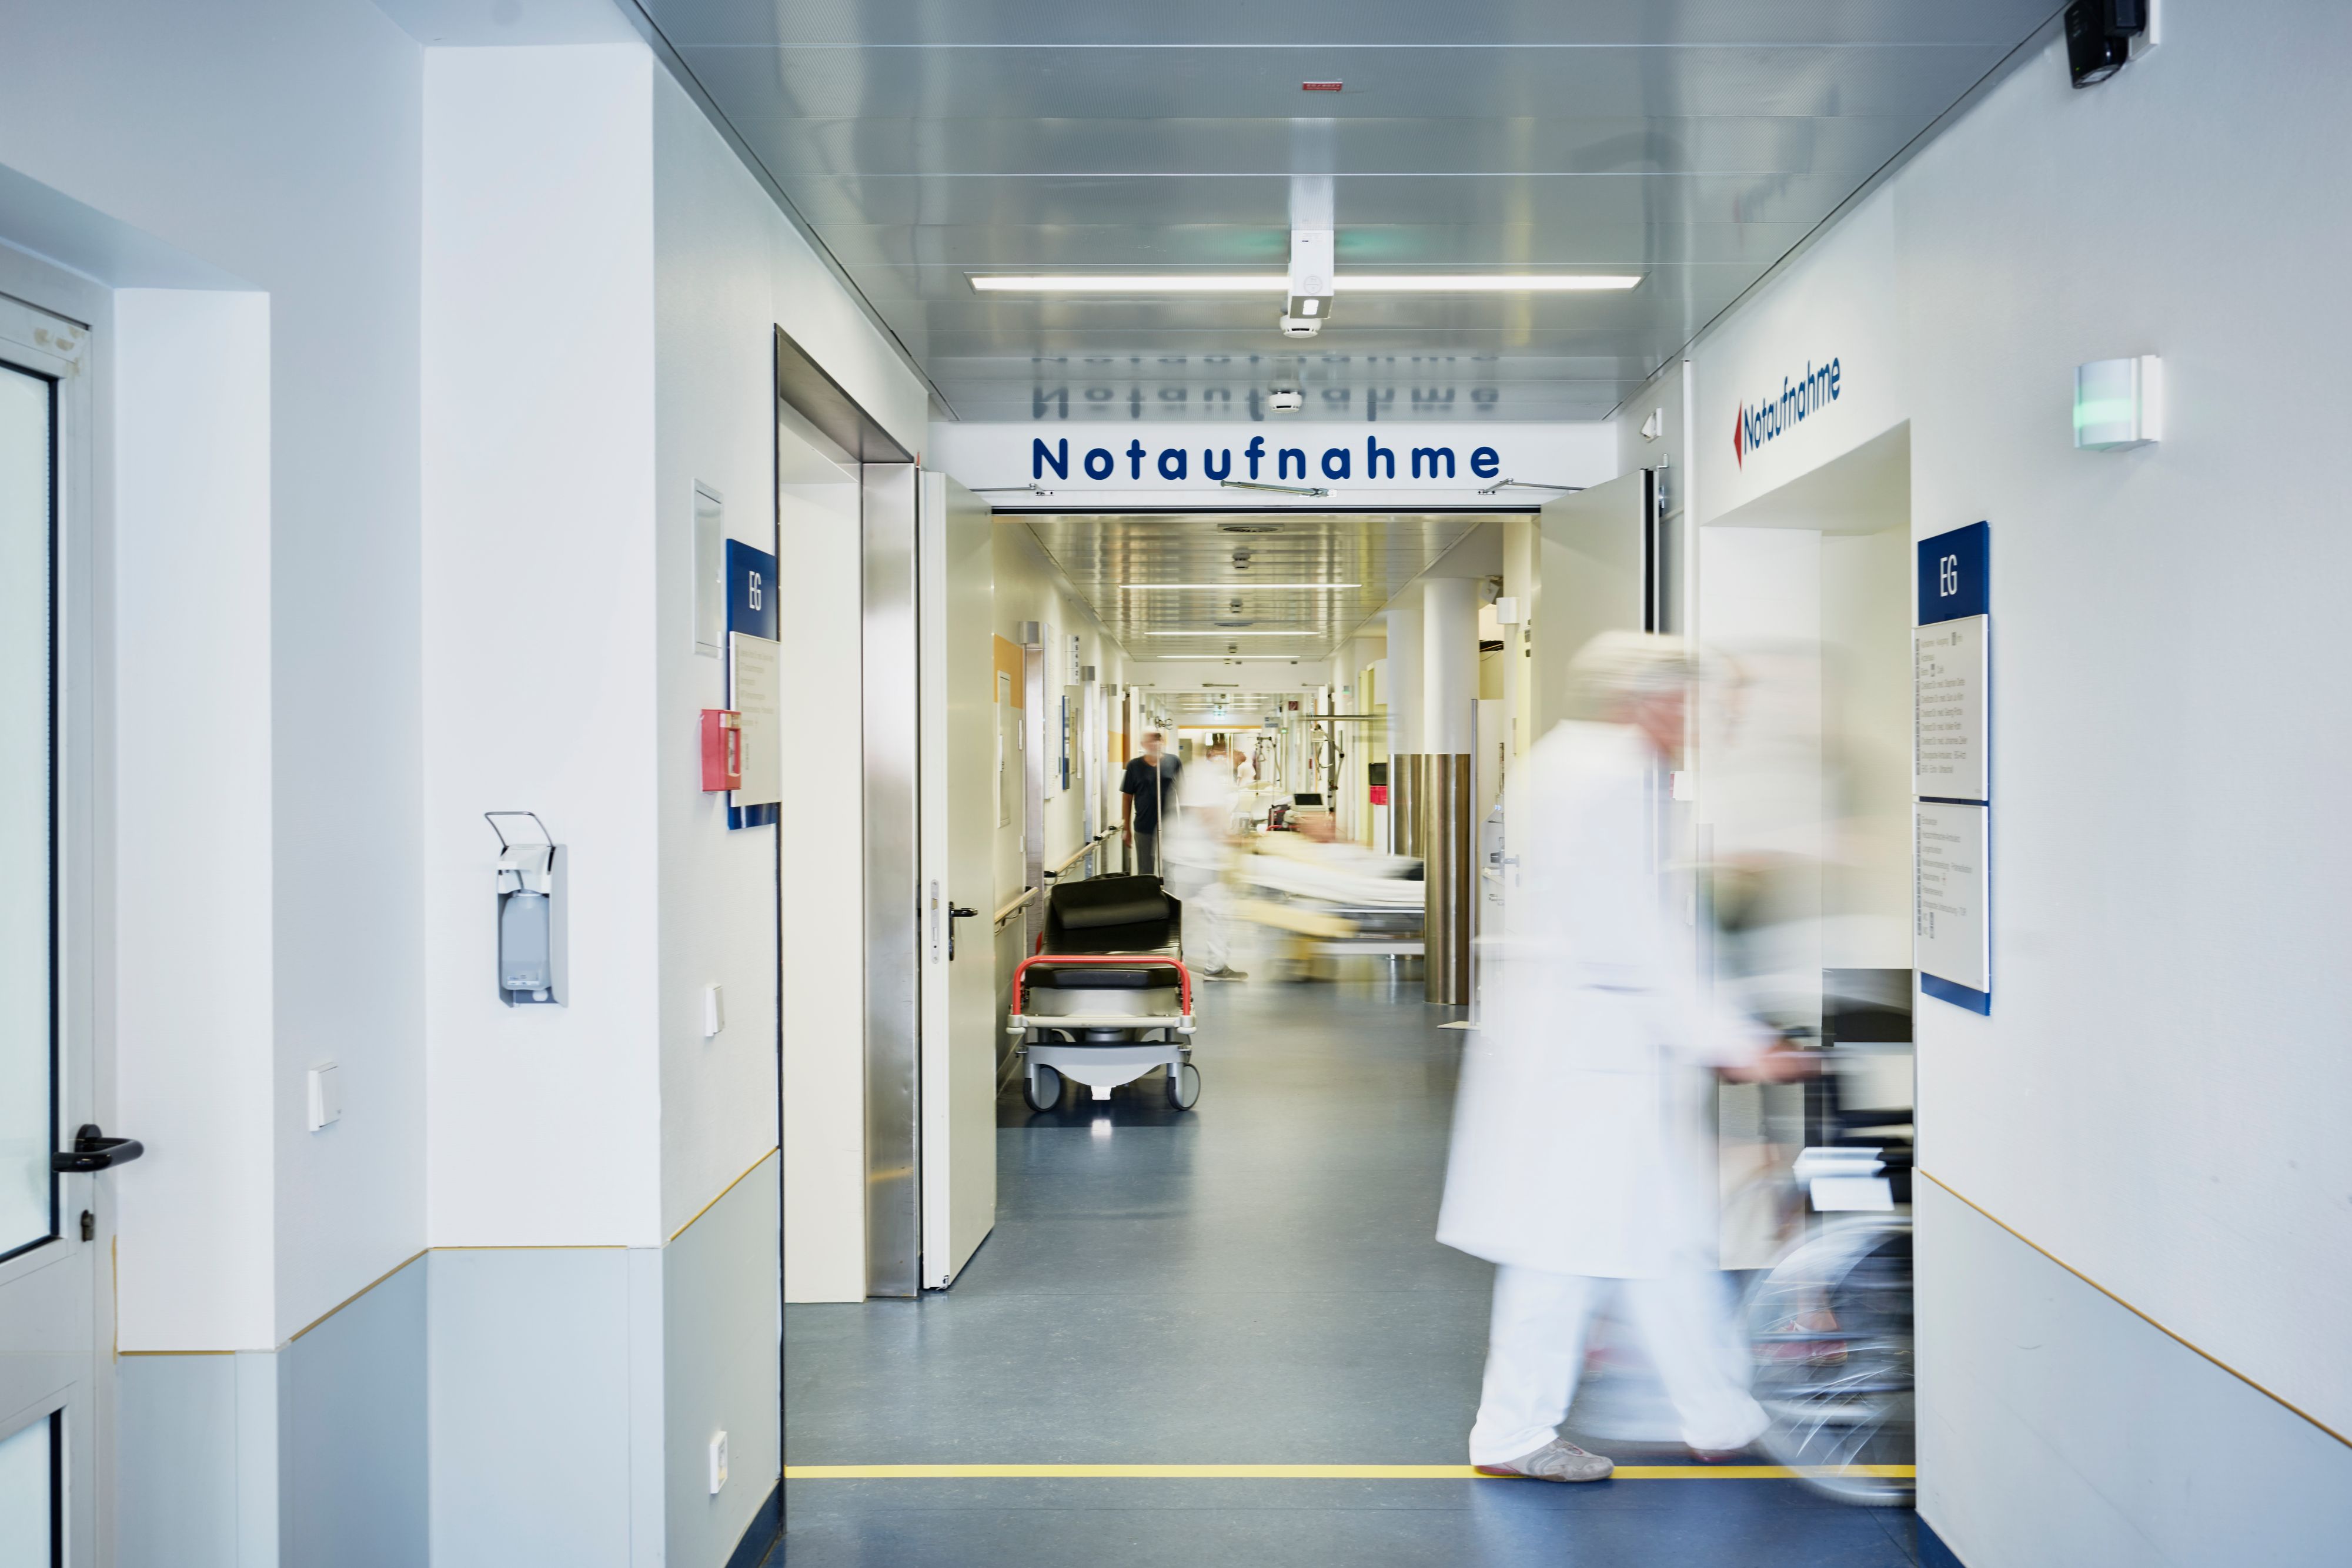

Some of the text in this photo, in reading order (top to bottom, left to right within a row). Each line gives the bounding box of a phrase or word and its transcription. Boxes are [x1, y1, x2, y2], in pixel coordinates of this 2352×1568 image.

[1743, 357, 1841, 454] Notaufnahme
[1033, 435, 1499, 480] Notaufnahme
[749, 570, 762, 611] EG
[1940, 554, 1957, 597] EG
